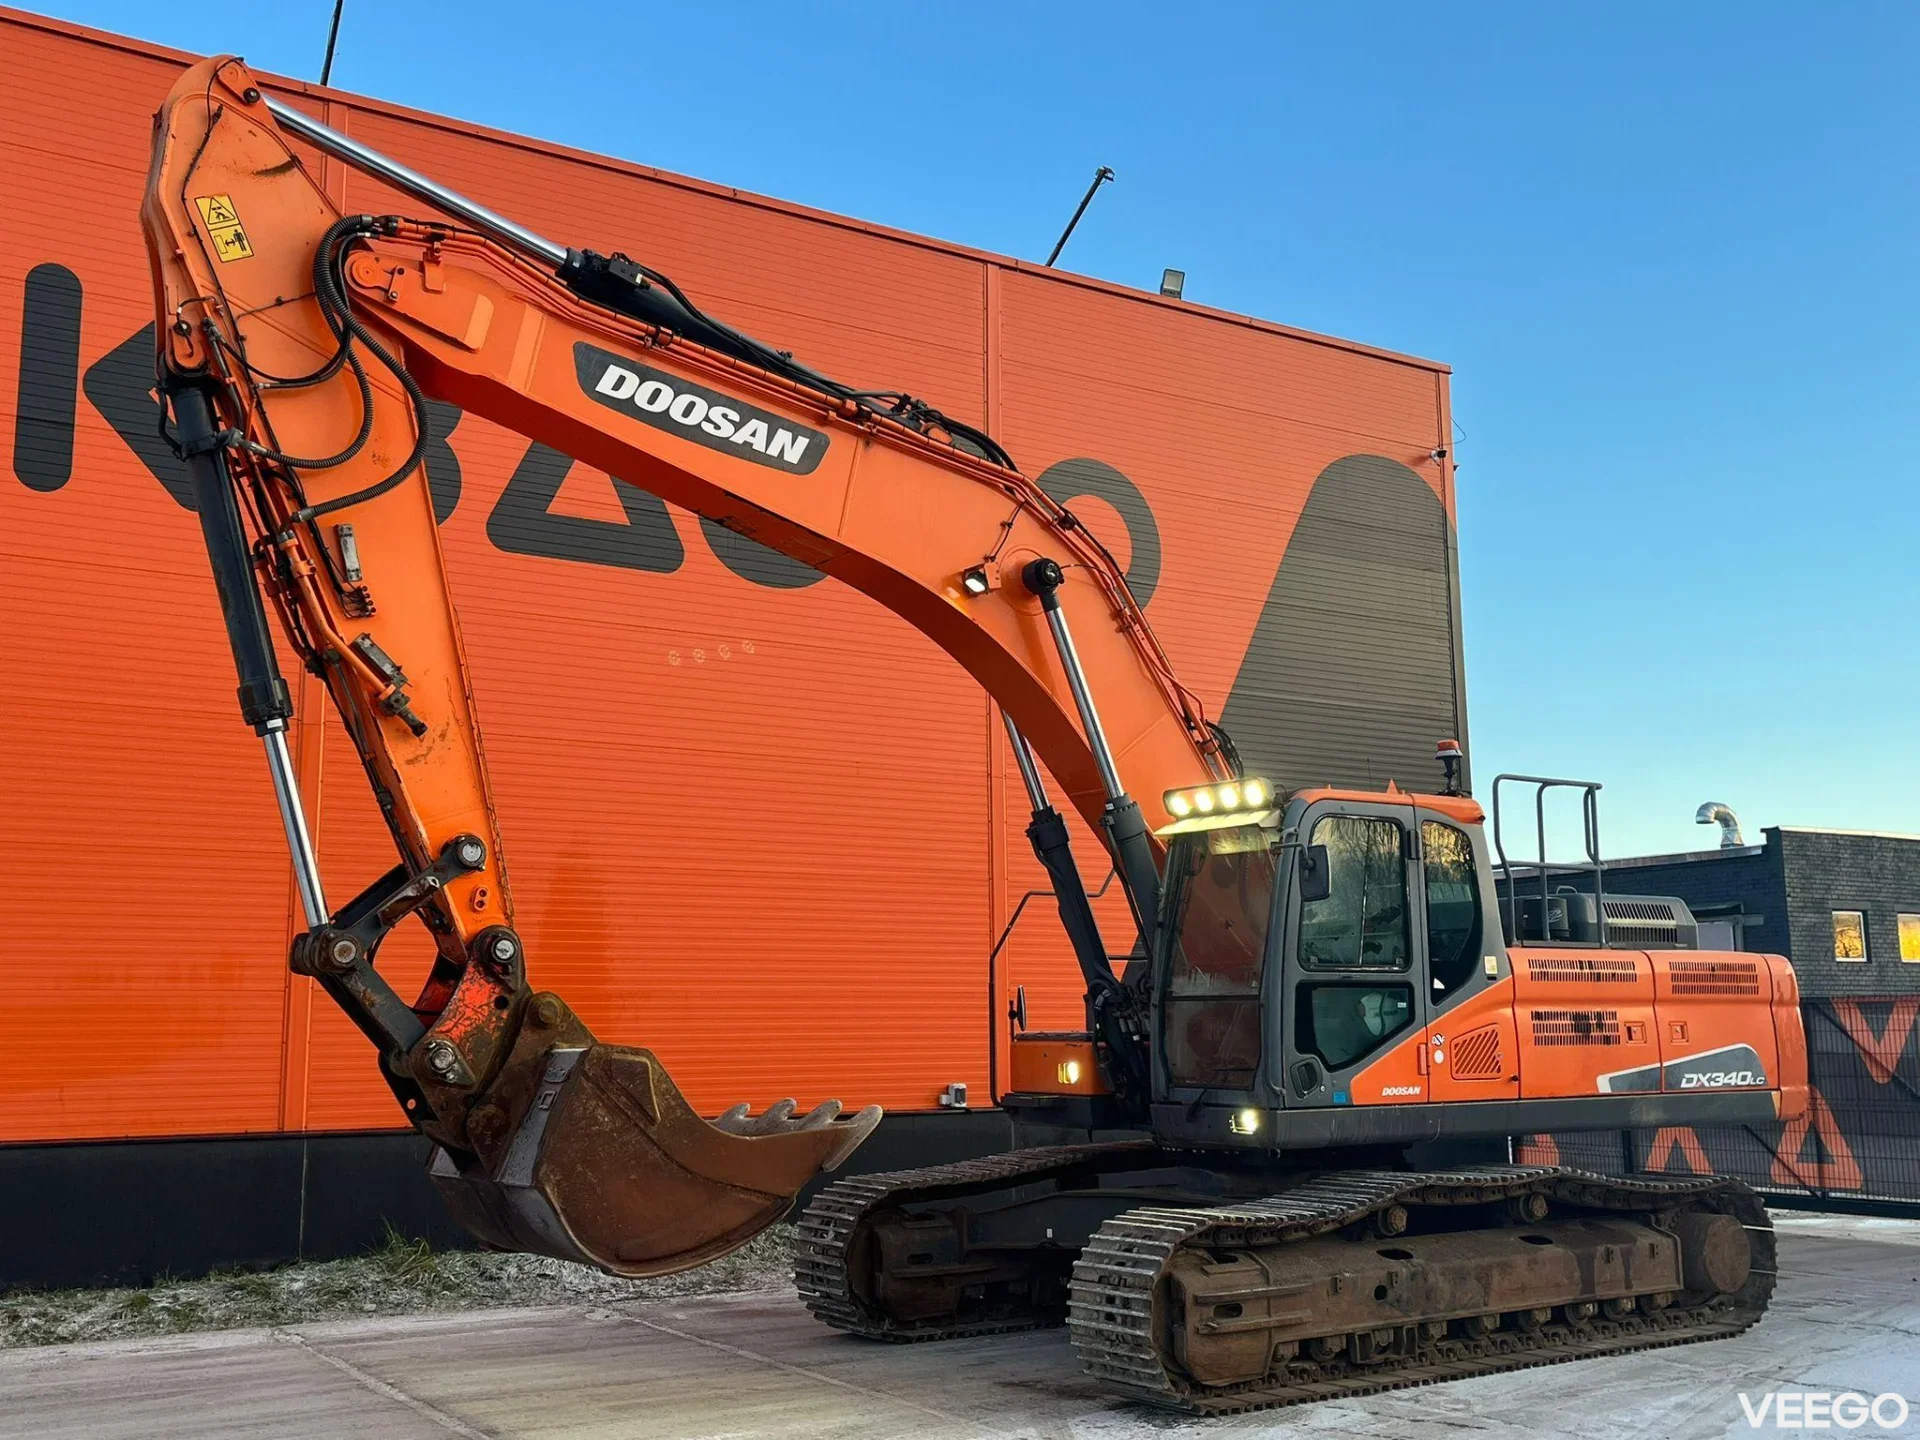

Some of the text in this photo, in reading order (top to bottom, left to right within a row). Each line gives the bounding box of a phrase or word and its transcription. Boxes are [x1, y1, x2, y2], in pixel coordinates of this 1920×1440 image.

[595, 363, 810, 465] DOOSAN
[1681, 1071, 1766, 1089] DX340LC
[1381, 1085, 1421, 1097] DOOSAN
